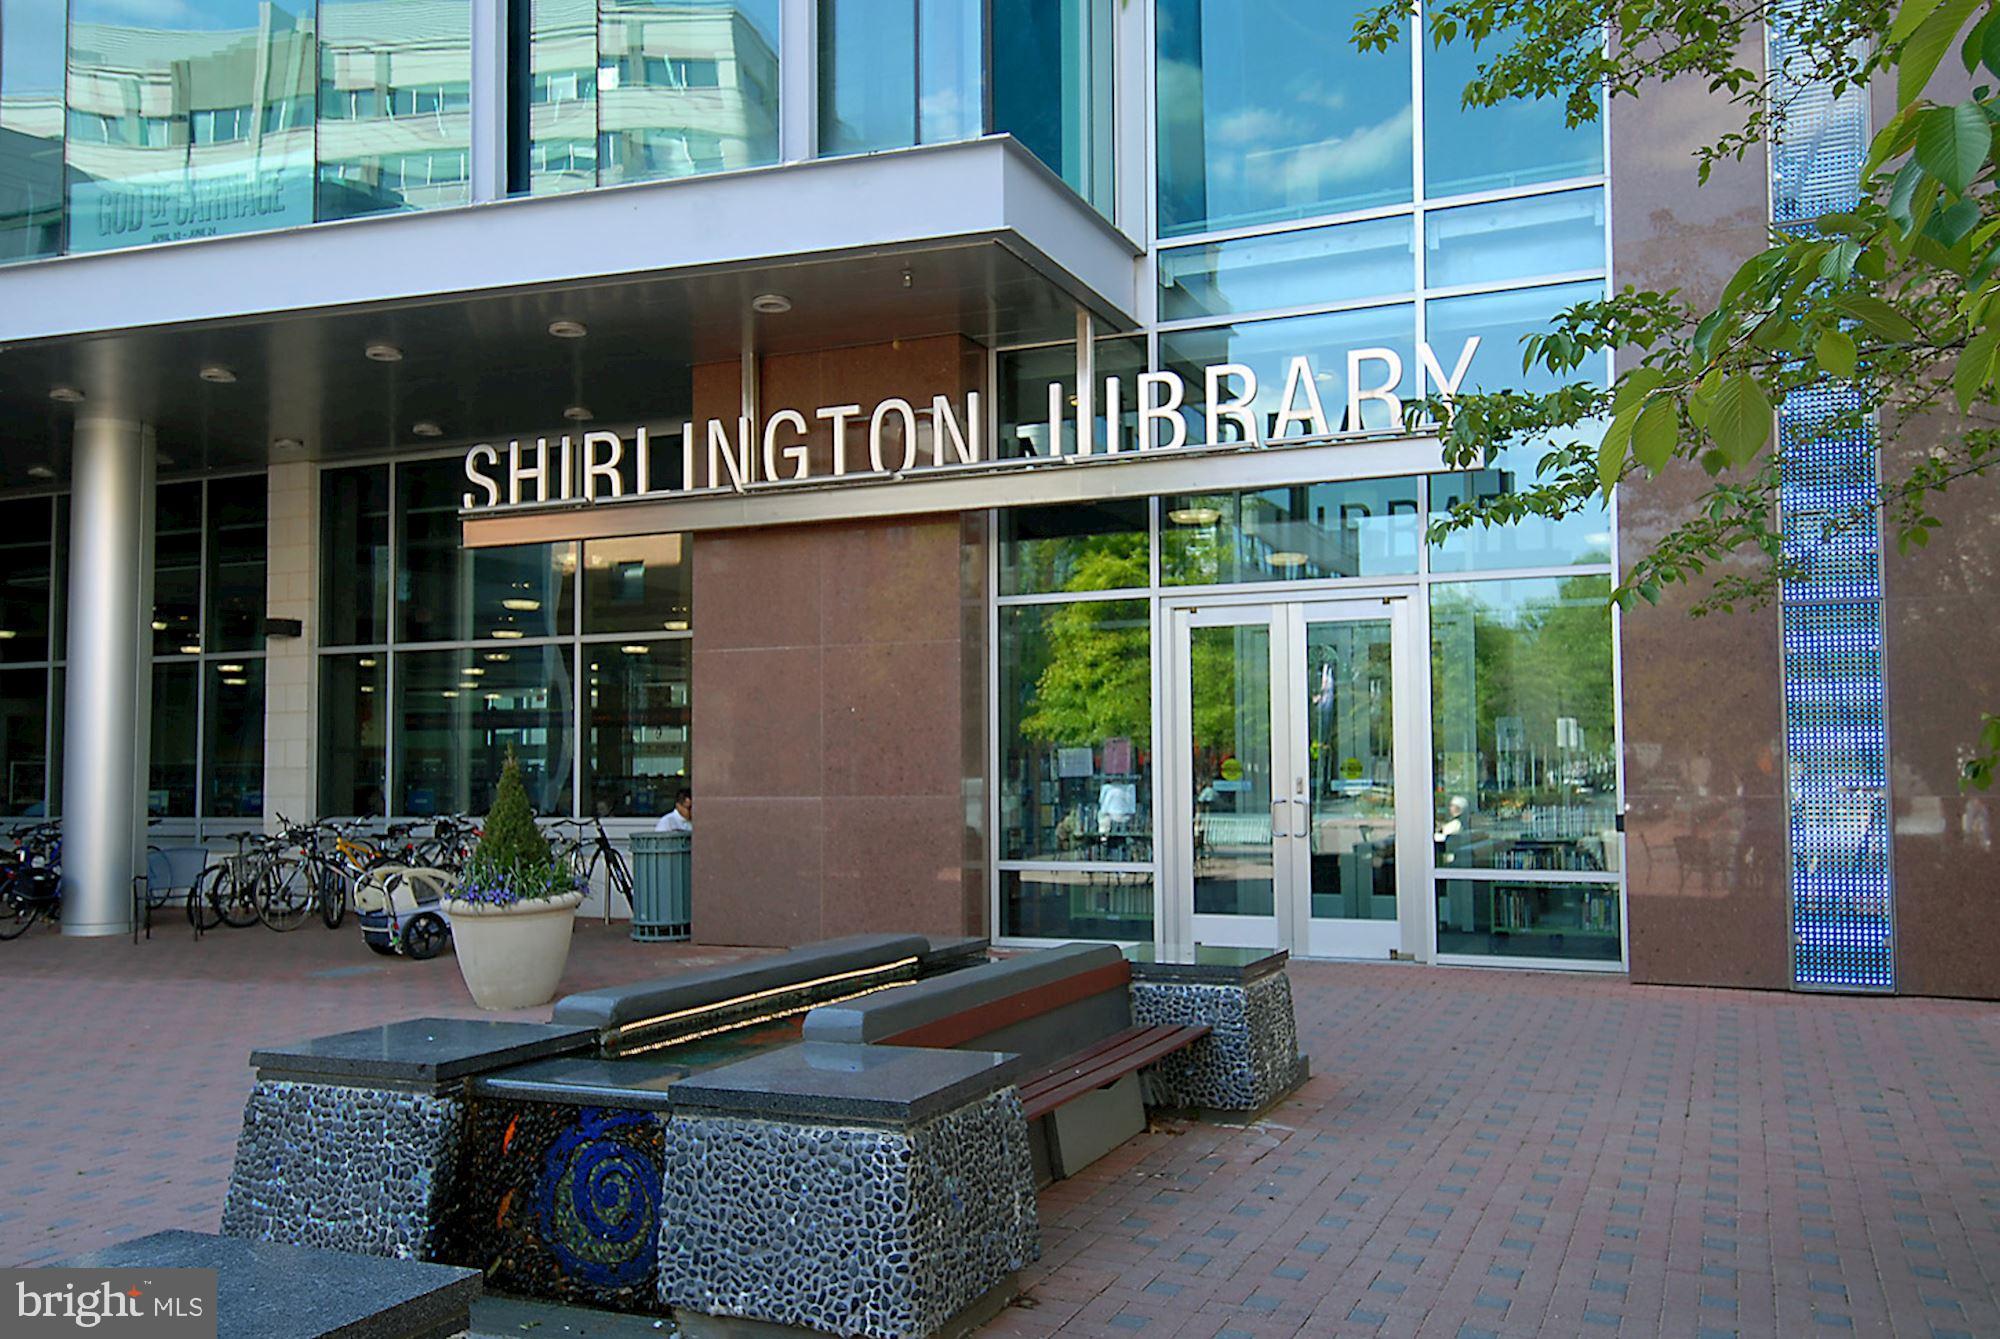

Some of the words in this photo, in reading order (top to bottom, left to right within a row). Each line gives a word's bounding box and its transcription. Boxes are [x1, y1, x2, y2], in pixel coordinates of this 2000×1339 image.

[99, 191, 143, 236] GOD
[463, 391, 980, 508] SHIRLINGTON
[1048, 336, 1482, 456] LIBRARY
